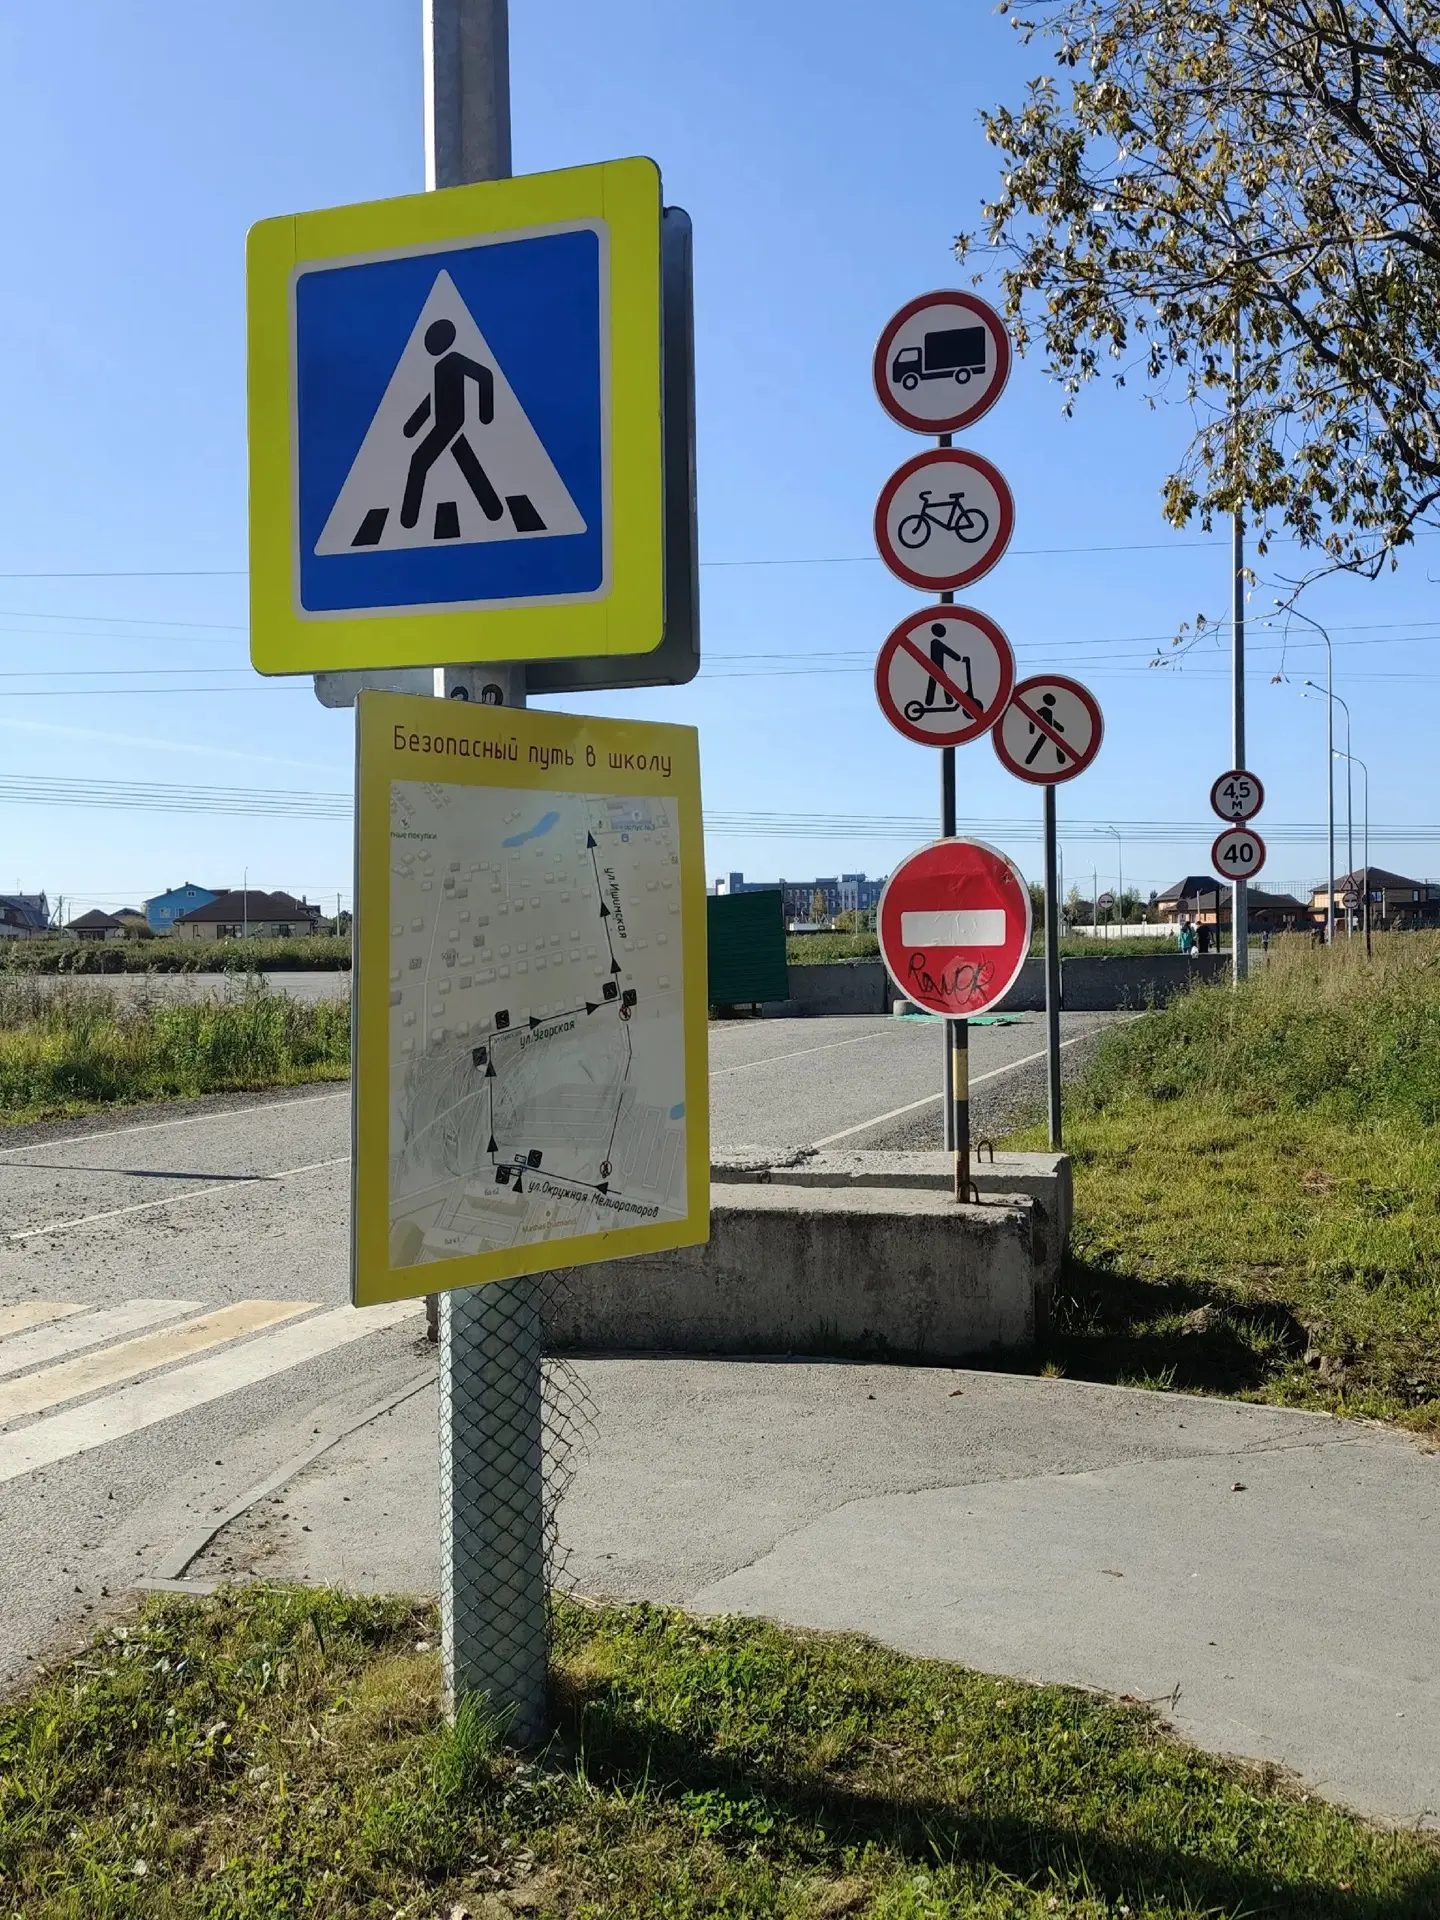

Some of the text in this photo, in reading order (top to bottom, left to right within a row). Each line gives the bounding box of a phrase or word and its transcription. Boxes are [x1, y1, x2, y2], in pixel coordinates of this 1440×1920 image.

[394, 724, 672, 778] Безопасный путь в школу
[1222, 781, 1251, 800] 4,5
[1222, 843, 1254, 864] 40
[603, 867, 627, 939] ул.Ишимская
[520, 1020, 575, 1050] ул.Угорская
[527, 1180, 660, 1218] ул.Окружная Мелиораторов
